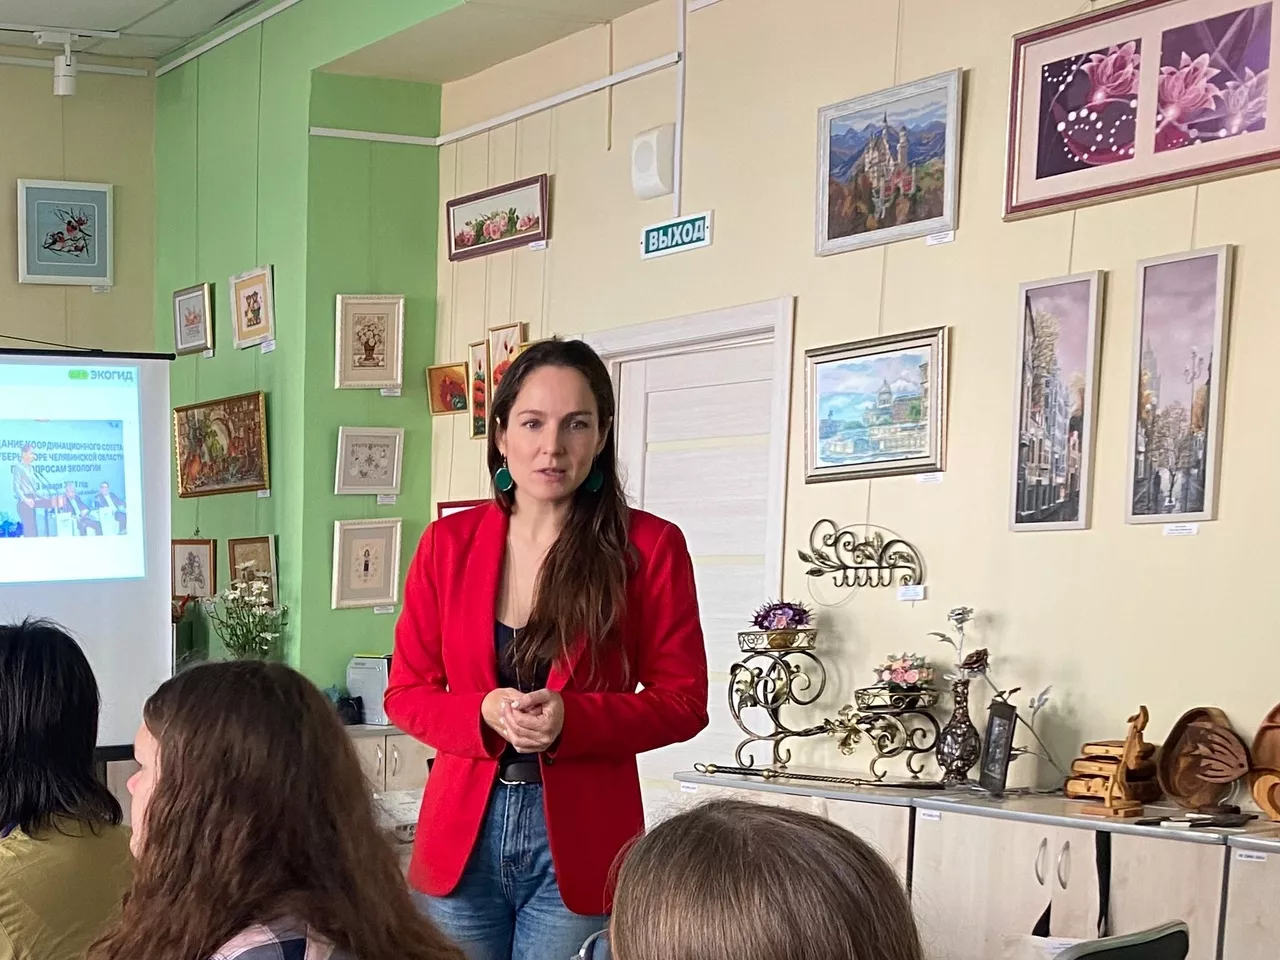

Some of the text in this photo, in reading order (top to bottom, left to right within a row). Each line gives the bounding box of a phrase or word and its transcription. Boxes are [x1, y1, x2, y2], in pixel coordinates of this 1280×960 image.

[648, 220, 704, 251] ВЫХОД
[90, 370, 133, 382] ЭКОГИД
[48, 452, 97, 462] ЧЕЛЯБИНСКОЙ
